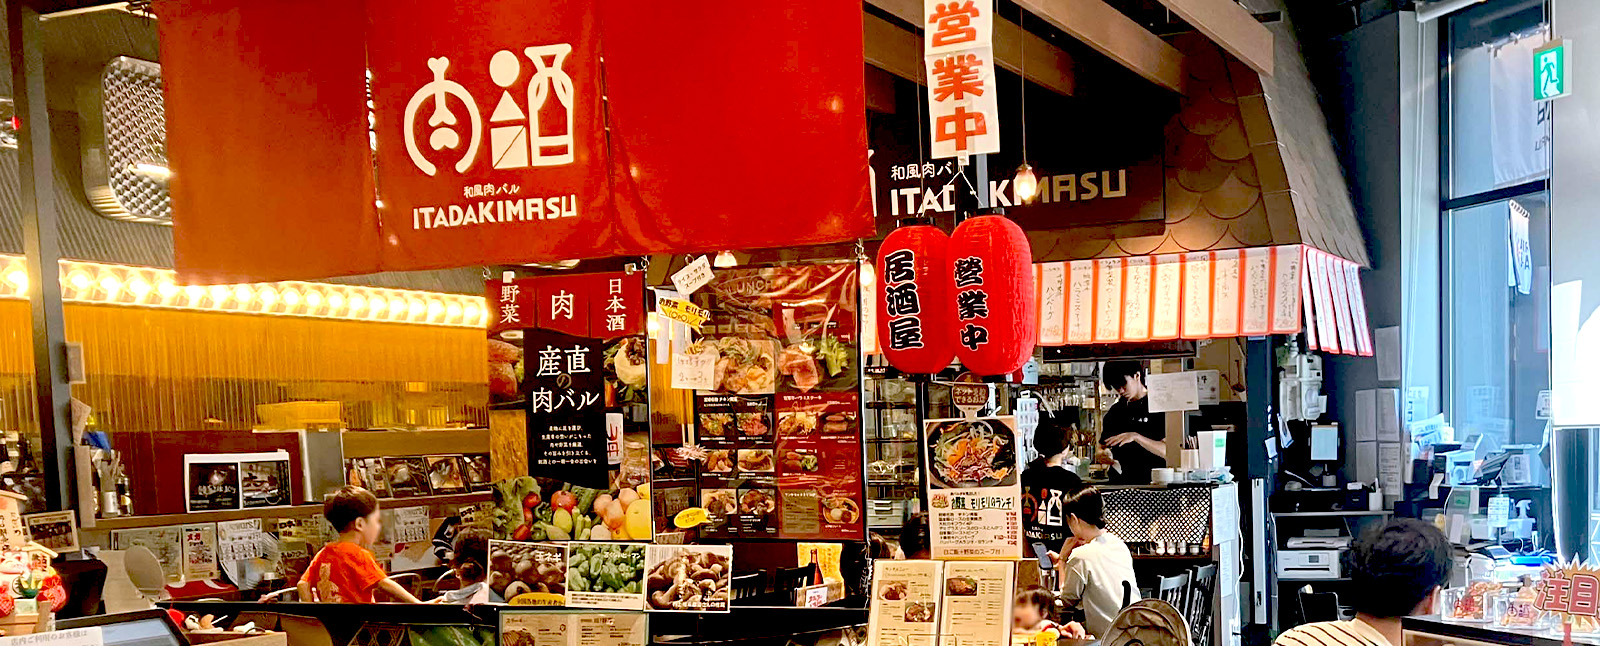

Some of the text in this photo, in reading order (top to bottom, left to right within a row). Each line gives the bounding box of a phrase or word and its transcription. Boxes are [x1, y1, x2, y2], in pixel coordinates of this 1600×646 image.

[928, 2, 988, 151] 営業中
[890, 161, 953, 181] 和風肉バ
[463, 183, 520, 198] 和風肉バル
[890, 168, 1127, 216] ITADKIMASU
[413, 194, 577, 230] ITADAKIMASU
[500, 285, 520, 324] 野菜
[551, 289, 575, 321] 肉
[605, 278, 627, 332] 日本酒
[884, 249, 924, 351] 居酒屋
[954, 256, 989, 351] 営業中
[536, 344, 591, 378] 産直
[532, 386, 600, 414] 肉バル
